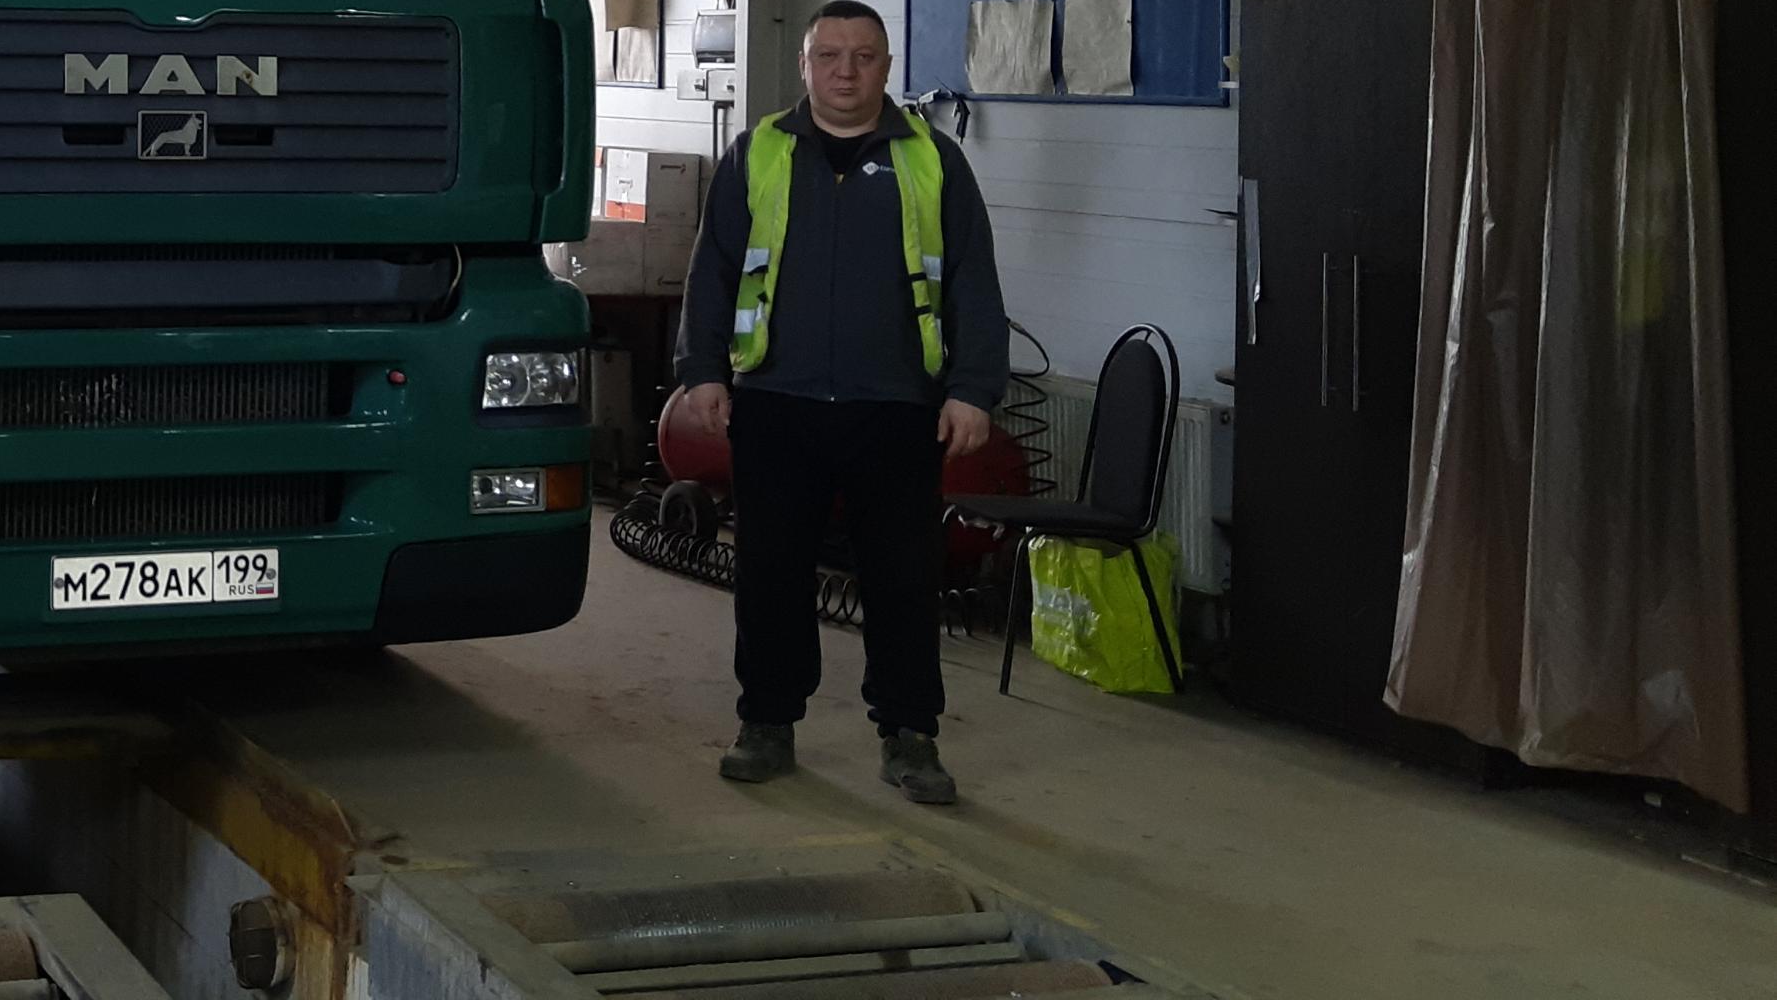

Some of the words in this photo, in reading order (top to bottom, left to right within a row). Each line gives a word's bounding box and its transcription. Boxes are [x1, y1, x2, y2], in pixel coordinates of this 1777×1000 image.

[64, 53, 278, 96] MAN
[217, 554, 268, 583] 199
[229, 584, 254, 596] RUS
